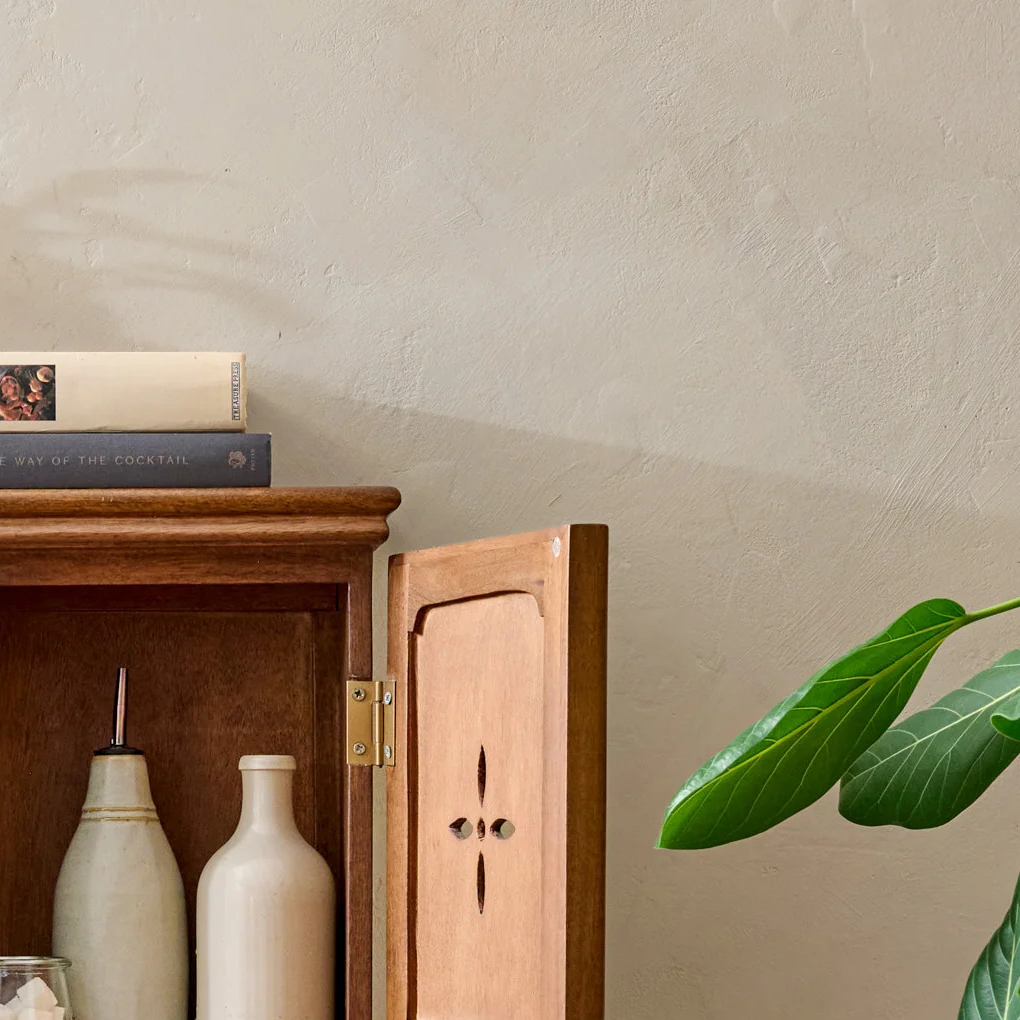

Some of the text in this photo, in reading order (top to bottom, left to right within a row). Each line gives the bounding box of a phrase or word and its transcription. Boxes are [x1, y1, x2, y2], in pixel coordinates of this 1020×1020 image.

[14, 456, 44, 466] WAY
[51, 456, 70, 466] OF
[78, 455, 108, 465] THE
[114, 455, 189, 465] COCKTAIL
